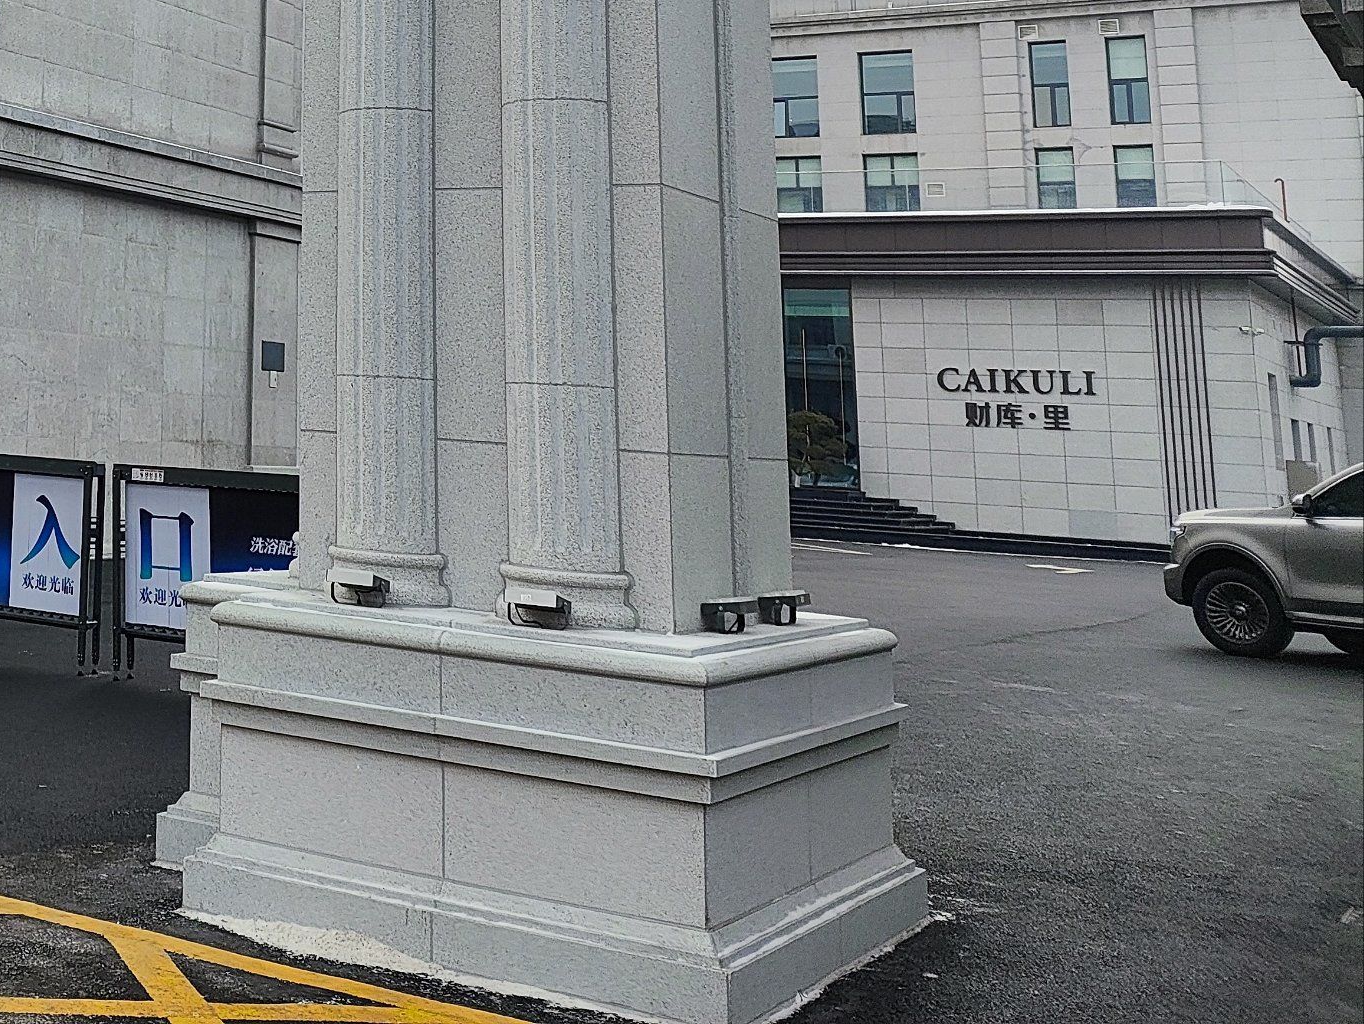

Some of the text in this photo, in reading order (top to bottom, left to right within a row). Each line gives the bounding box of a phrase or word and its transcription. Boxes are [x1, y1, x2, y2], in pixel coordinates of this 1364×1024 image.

[937, 367, 1096, 396] CAIKULI
[965, 402, 1071, 431] 财库·里
[20, 494, 80, 569] 入
[139, 508, 194, 582] 口
[22, 573, 74, 596] 欢迎光临
[139, 586, 188, 609] 欢迎光
